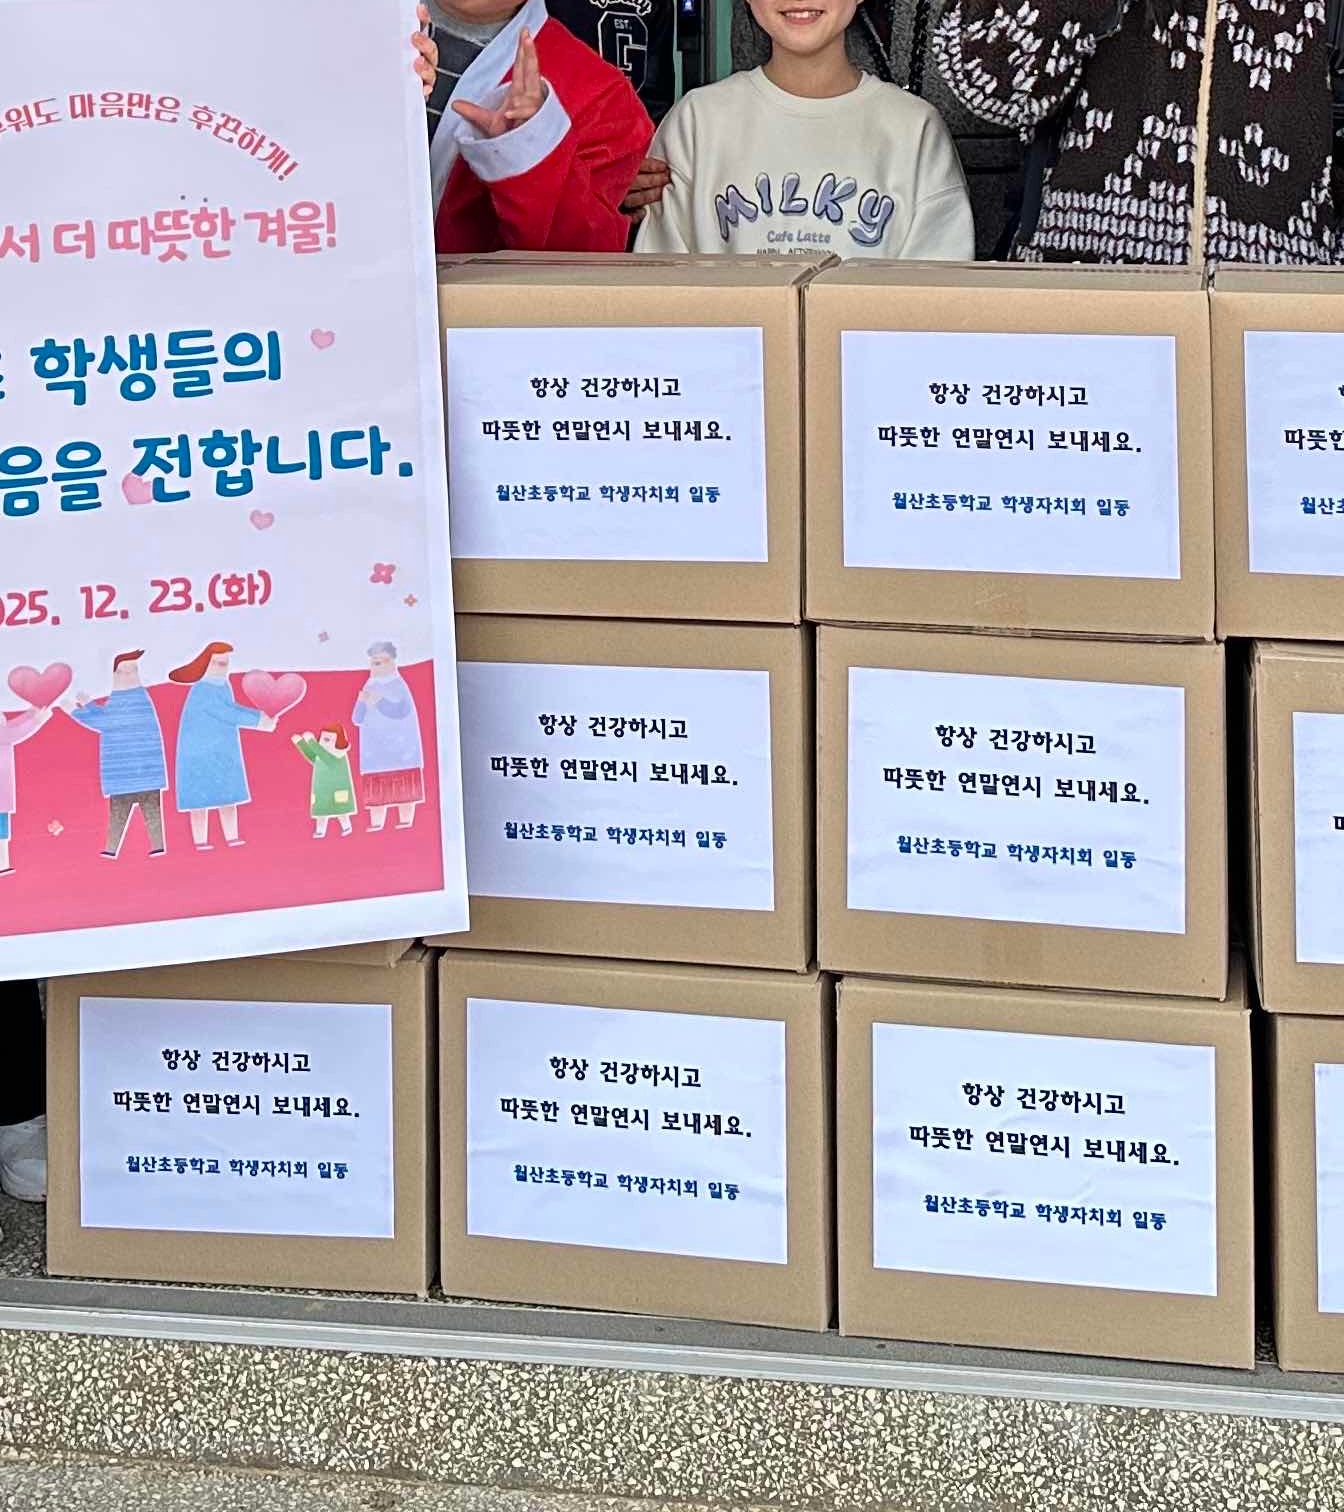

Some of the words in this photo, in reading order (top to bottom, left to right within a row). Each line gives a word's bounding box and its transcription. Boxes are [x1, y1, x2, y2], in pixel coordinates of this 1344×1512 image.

[69, 91, 182, 123] 마음만은
[188, 105, 299, 181] 후끈하게!
[54, 222, 95, 257] 더
[108, 208, 234, 261] 따뜻한
[247, 201, 336, 253] 겨울!
[32, 330, 281, 406] 학생들의
[529, 376, 570, 399] 항상
[579, 376, 682, 399] 건강하시고
[927, 381, 971, 405] 항상
[980, 383, 1089, 407] 건강하시고
[480, 418, 542, 441] 따뜻한
[551, 419, 630, 441] 연말연시
[641, 419, 732, 442] 보내세요.
[876, 424, 941, 448] 따뜻한
[951, 426, 1034, 451] 연말연시
[1046, 429, 1142, 453] 보내세요.
[134, 426, 413, 503] 전합니다.
[494, 483, 591, 503] 월산초등학교
[597, 484, 679, 503] 학생자치회
[688, 485, 721, 504] 일동
[890, 491, 993, 512] 월산초등학교
[1000, 494, 1086, 516] 학생자치회
[1095, 497, 1130, 517] 일동
[80, 584, 128, 619] 12.
[149, 570, 272, 614] 23.(화)
[537, 712, 578, 737] 항상
[587, 715, 688, 740] 건강하시고
[934, 723, 978, 749] 항상
[987, 727, 1097, 756] 건강하시고
[489, 755, 550, 779] 따뜻한
[559, 757, 638, 783] 연말연시
[648, 762, 738, 786] 보내세요.
[881, 766, 947, 792] 따뜻한
[957, 771, 1041, 799] 연말연시
[1053, 777, 1149, 805] 보내세요.
[502, 820, 598, 843] 월산초등학교
[605, 825, 686, 848] 학생자치회
[694, 829, 728, 849] 일동
[895, 834, 998, 859] 월산초등학교
[1005, 842, 1092, 867] 학생자치회
[1102, 848, 1137, 869] 일동
[160, 1047, 201, 1072] 항상
[210, 1049, 312, 1074] 건강하시고
[548, 1055, 590, 1081] 항상
[598, 1060, 702, 1089] 건강하시고
[112, 1089, 173, 1113] 따뜻한
[182, 1091, 260, 1116] 연말연시
[270, 1095, 360, 1118] 보내세요.
[960, 1081, 1006, 1108] 항상
[1015, 1086, 1126, 1116] 건강하시고
[499, 1096, 560, 1123] 따뜻한
[569, 1102, 649, 1131] 연말연시
[660, 1110, 752, 1138] 보내세요.
[907, 1124, 974, 1151] 따뜻한
[984, 1130, 1070, 1159] 연말연시
[1082, 1137, 1179, 1166] 보내세요.
[125, 1154, 221, 1175] 월산초등학교
[227, 1157, 308, 1179] 학생자치회
[316, 1160, 349, 1180] 일동
[512, 1163, 609, 1189] 월산초등학교
[615, 1173, 698, 1198] 학생자치회
[707, 1181, 740, 1201] 일동
[922, 1193, 1027, 1219] 월산초등학교
[1034, 1202, 1122, 1228] 학생자치회
[1131, 1210, 1167, 1231] 일동
